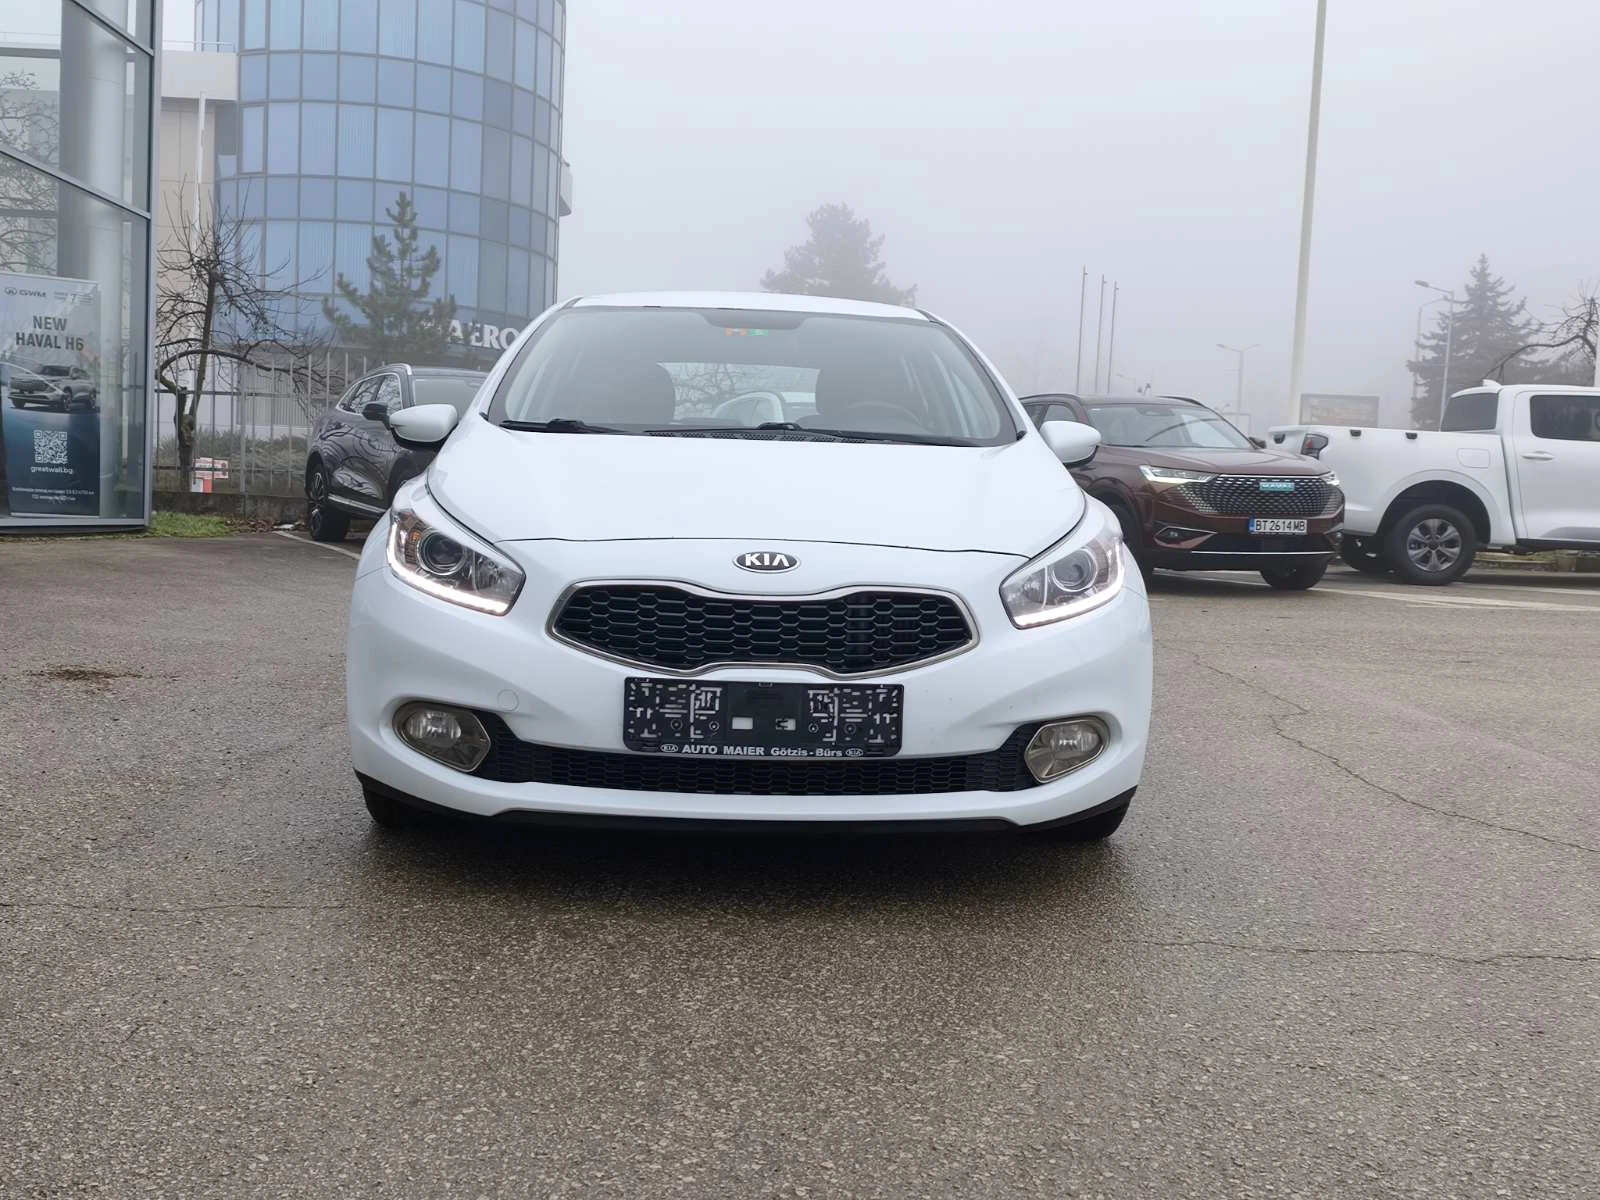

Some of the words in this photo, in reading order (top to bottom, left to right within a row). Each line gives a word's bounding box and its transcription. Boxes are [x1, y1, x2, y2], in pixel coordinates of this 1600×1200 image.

[33, 315, 67, 331] NEW
[16, 332, 62, 349] HAVAL
[65, 336, 85, 351] H6
[745, 553, 790, 567] KIA
[663, 744, 677, 752] KIA
[682, 744, 718, 754] AUTO
[723, 745, 765, 756] MAIER
